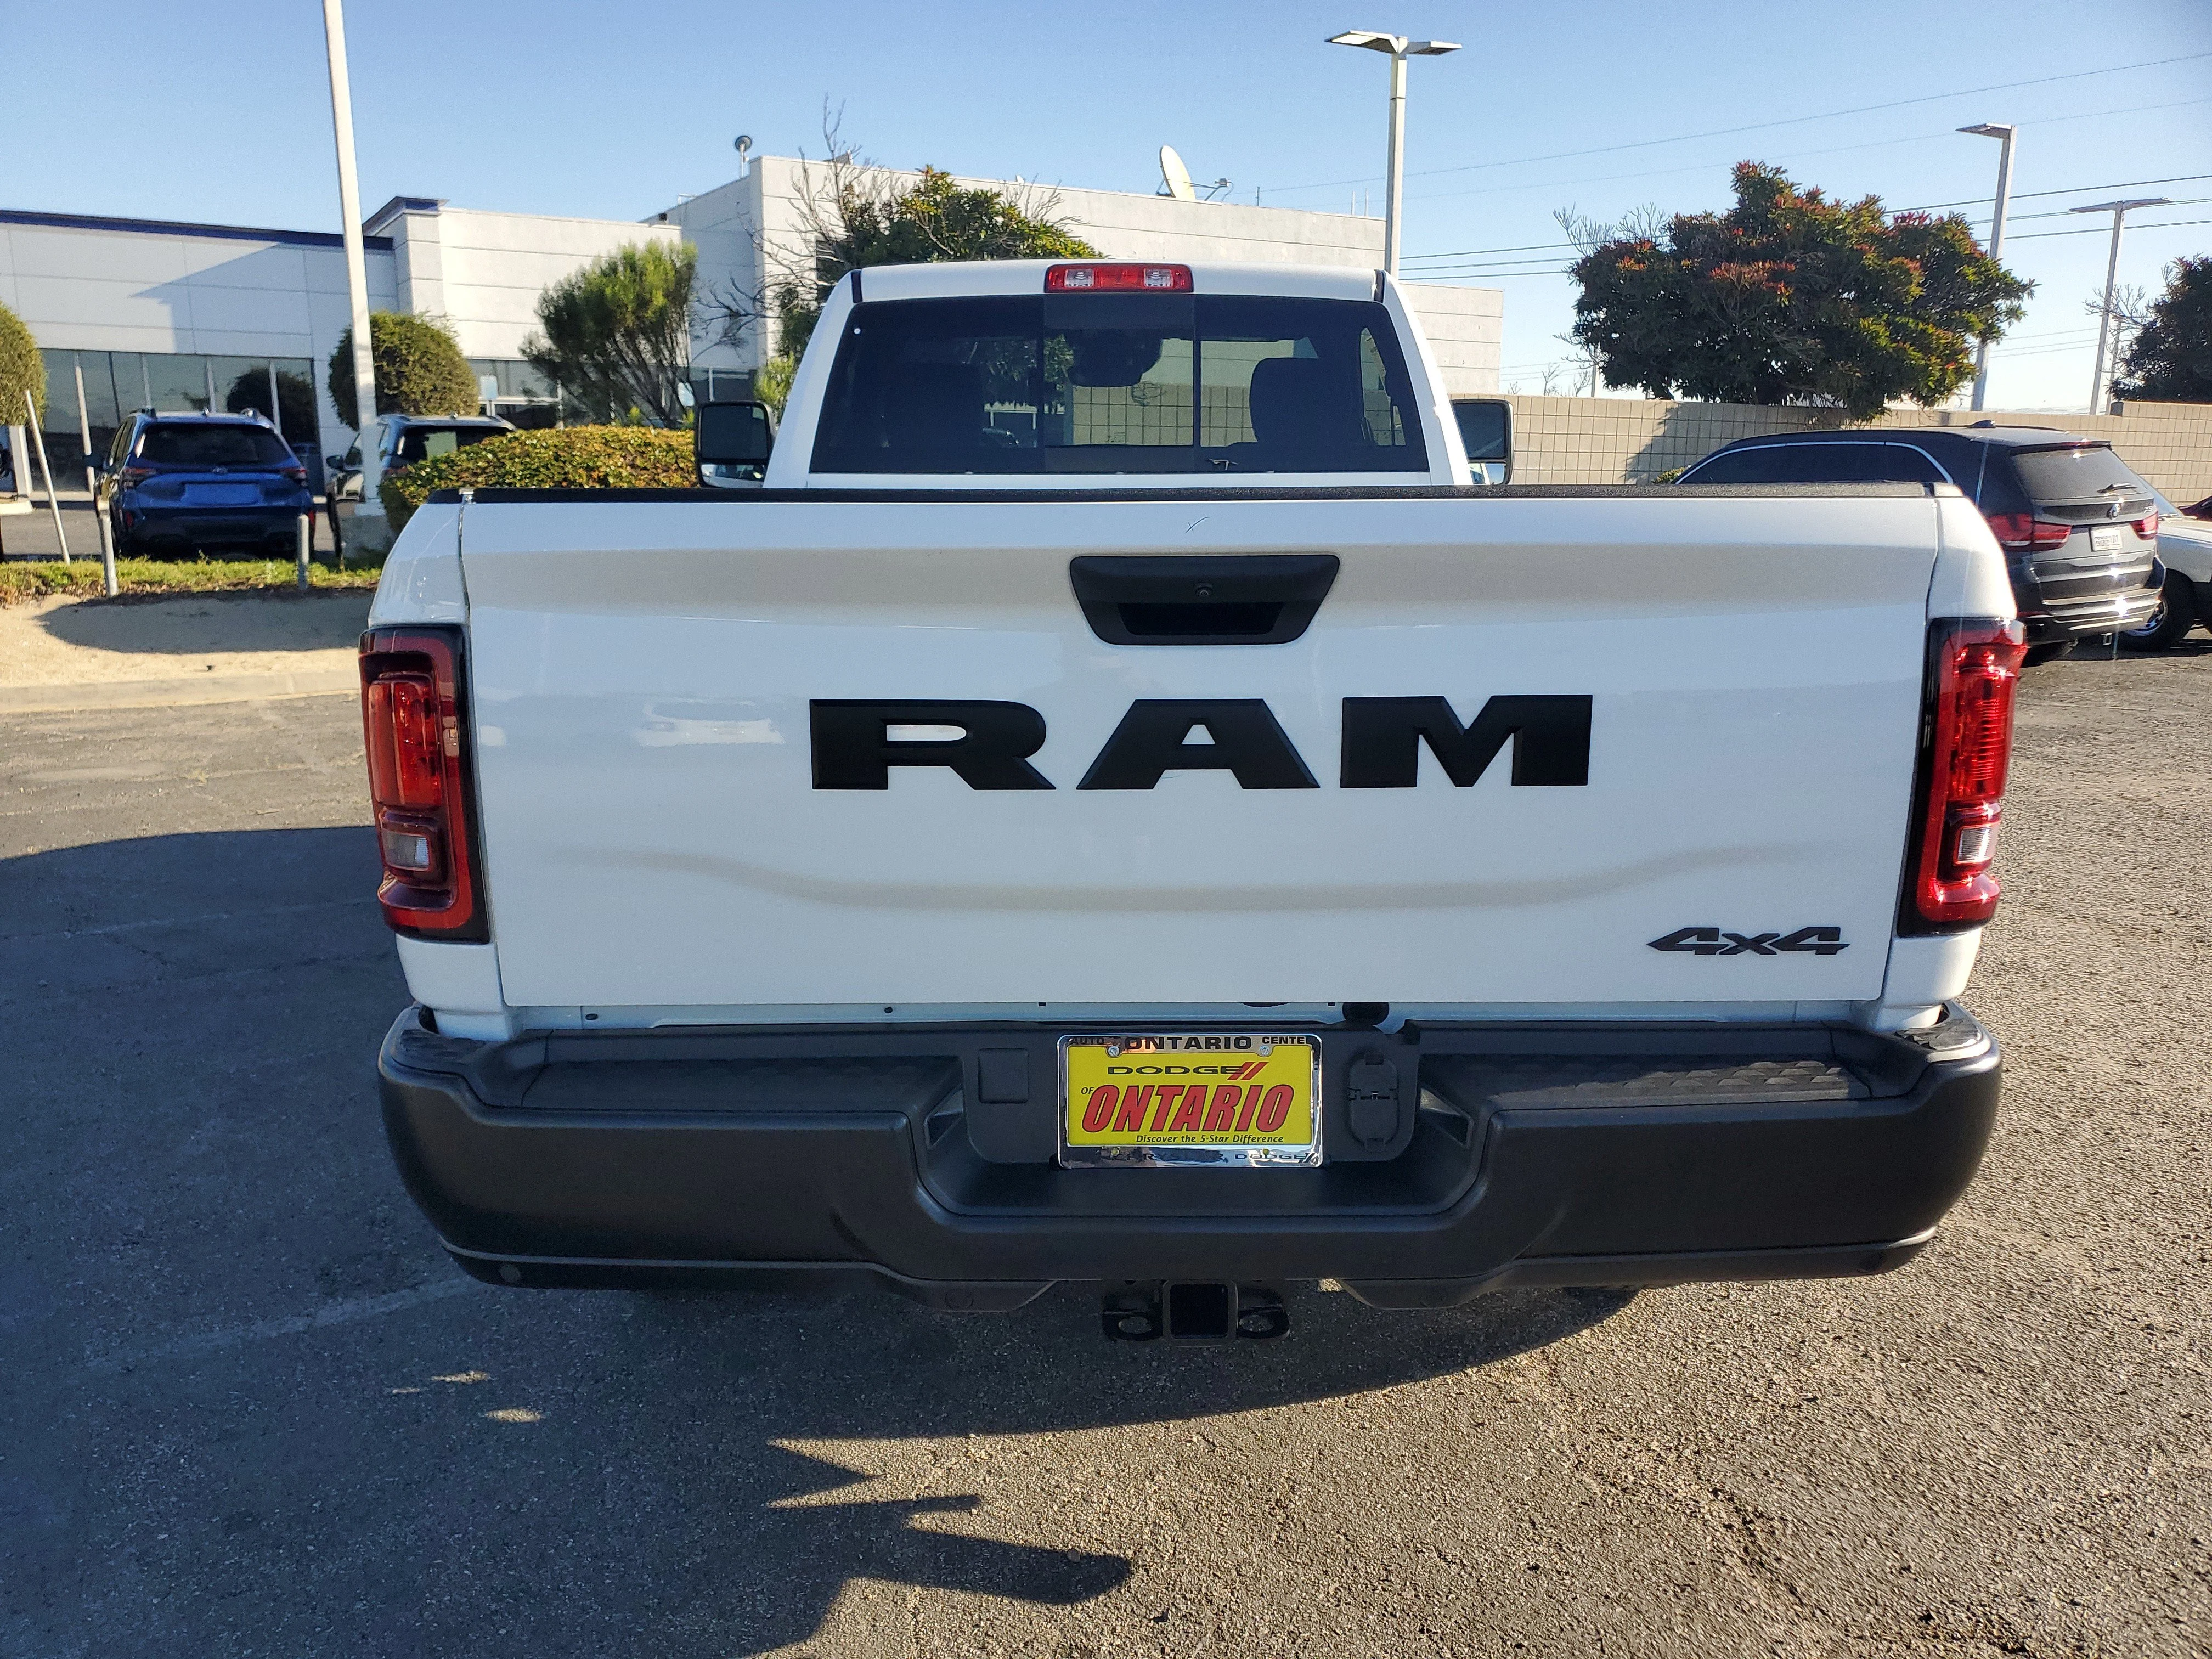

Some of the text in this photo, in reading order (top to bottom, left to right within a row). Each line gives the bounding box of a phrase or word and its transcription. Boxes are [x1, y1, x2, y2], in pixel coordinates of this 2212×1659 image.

[809, 693, 1593, 791] RAM
[1646, 927, 1850, 956] 4x4
[1125, 1036, 1252, 1050] ONTARIO
[1262, 1036, 1309, 1045] CENTE
[1107, 1066, 1245, 1074] DODGE
[1081, 1084, 1294, 1133] OF ONTARIO
[1136, 1135, 1284, 1144] Discover the 5-Star Difference
